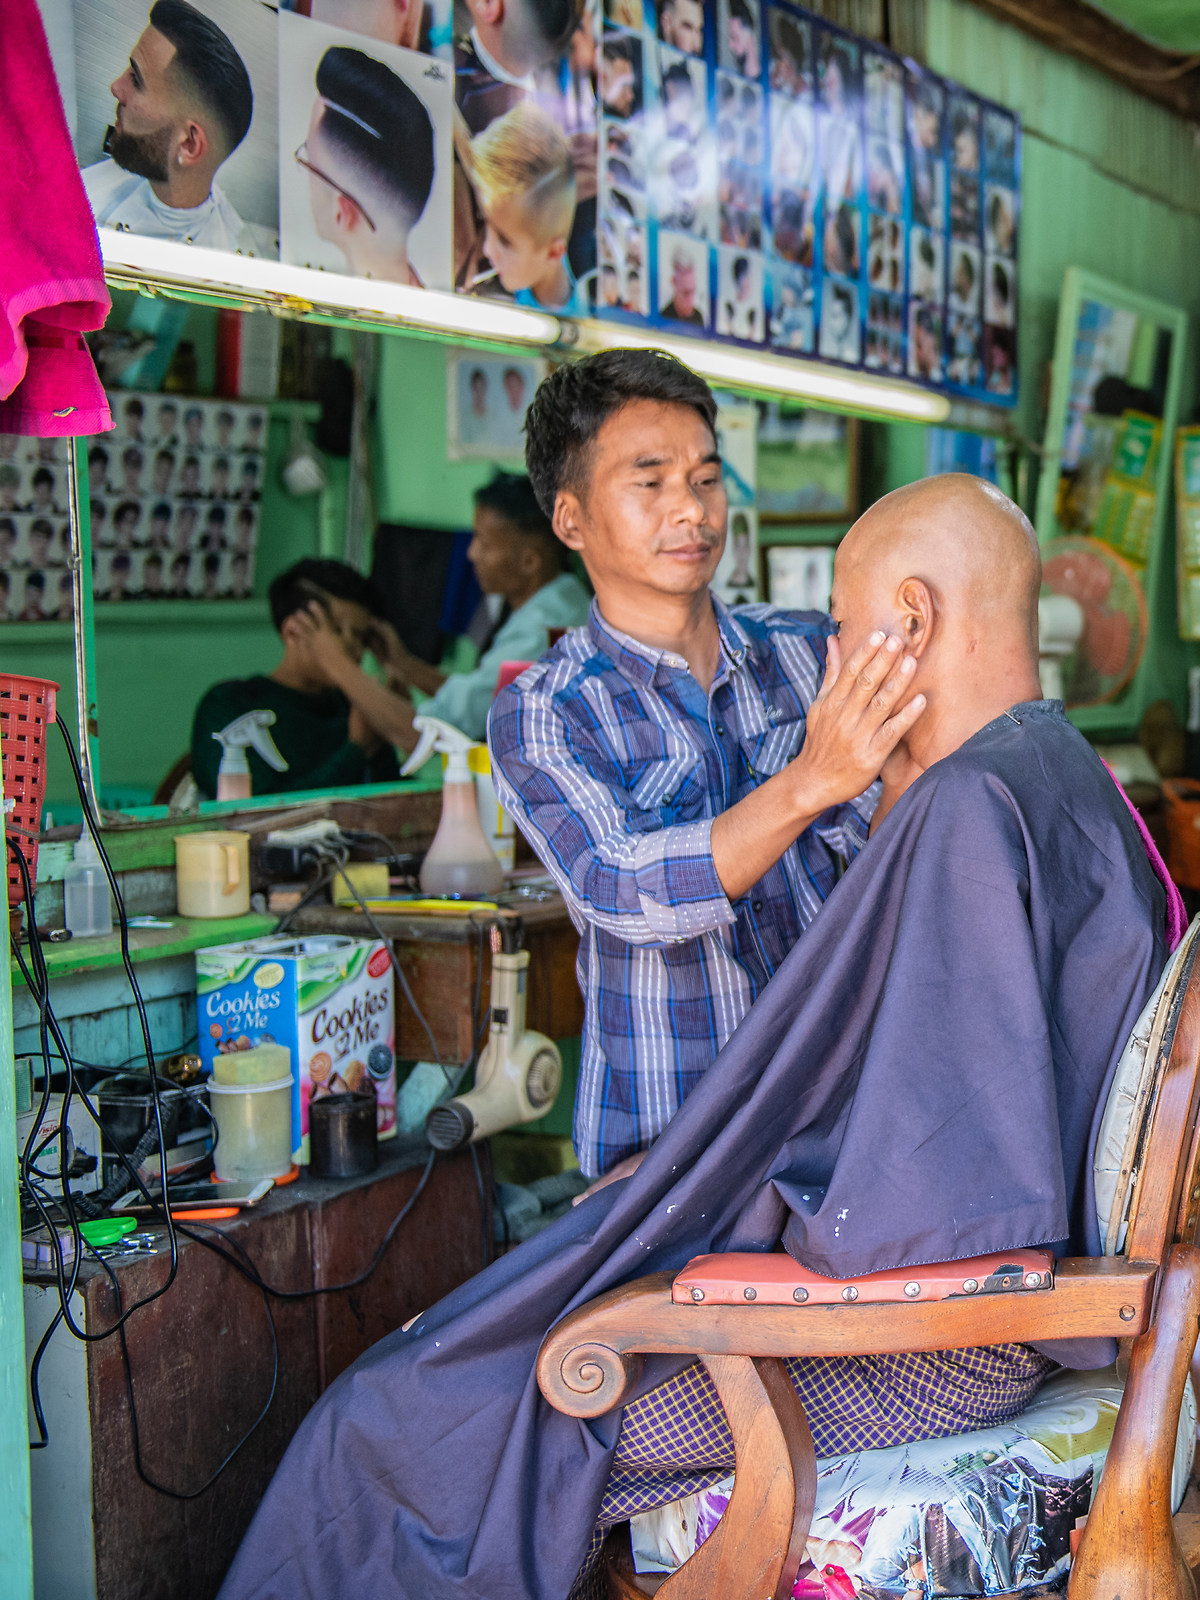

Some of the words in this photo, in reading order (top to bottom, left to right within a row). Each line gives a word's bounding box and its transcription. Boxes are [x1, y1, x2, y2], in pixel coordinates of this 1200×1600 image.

[206, 987, 281, 1018] Cookies
[310, 987, 389, 1045] Cookies
[244, 1012, 269, 1031] Me
[353, 1019, 380, 1051] Me
